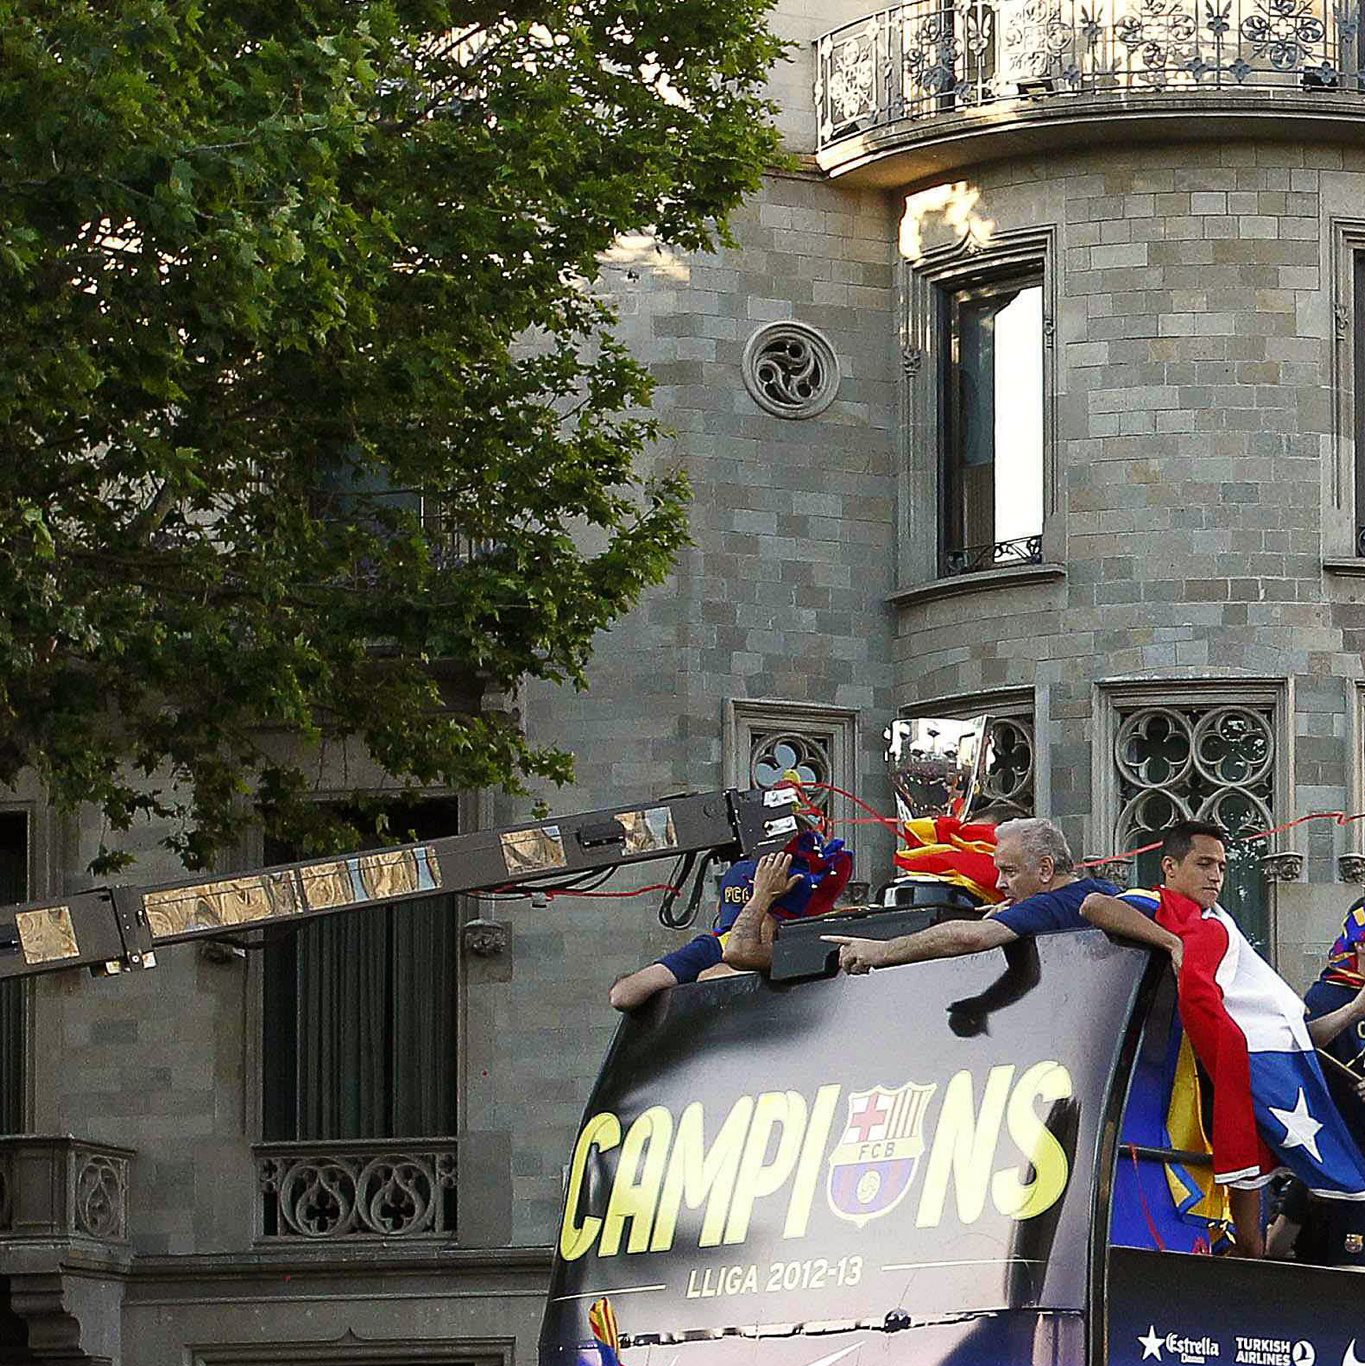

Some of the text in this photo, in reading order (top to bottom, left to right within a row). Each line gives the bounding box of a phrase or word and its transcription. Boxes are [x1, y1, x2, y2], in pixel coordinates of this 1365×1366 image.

[858, 1142, 896, 1160] FCB
[686, 1255, 864, 1299] LLIGA 2012-13
[1165, 1332, 1220, 1357] Estrella
[1235, 1337, 1291, 1354] TURKISH
